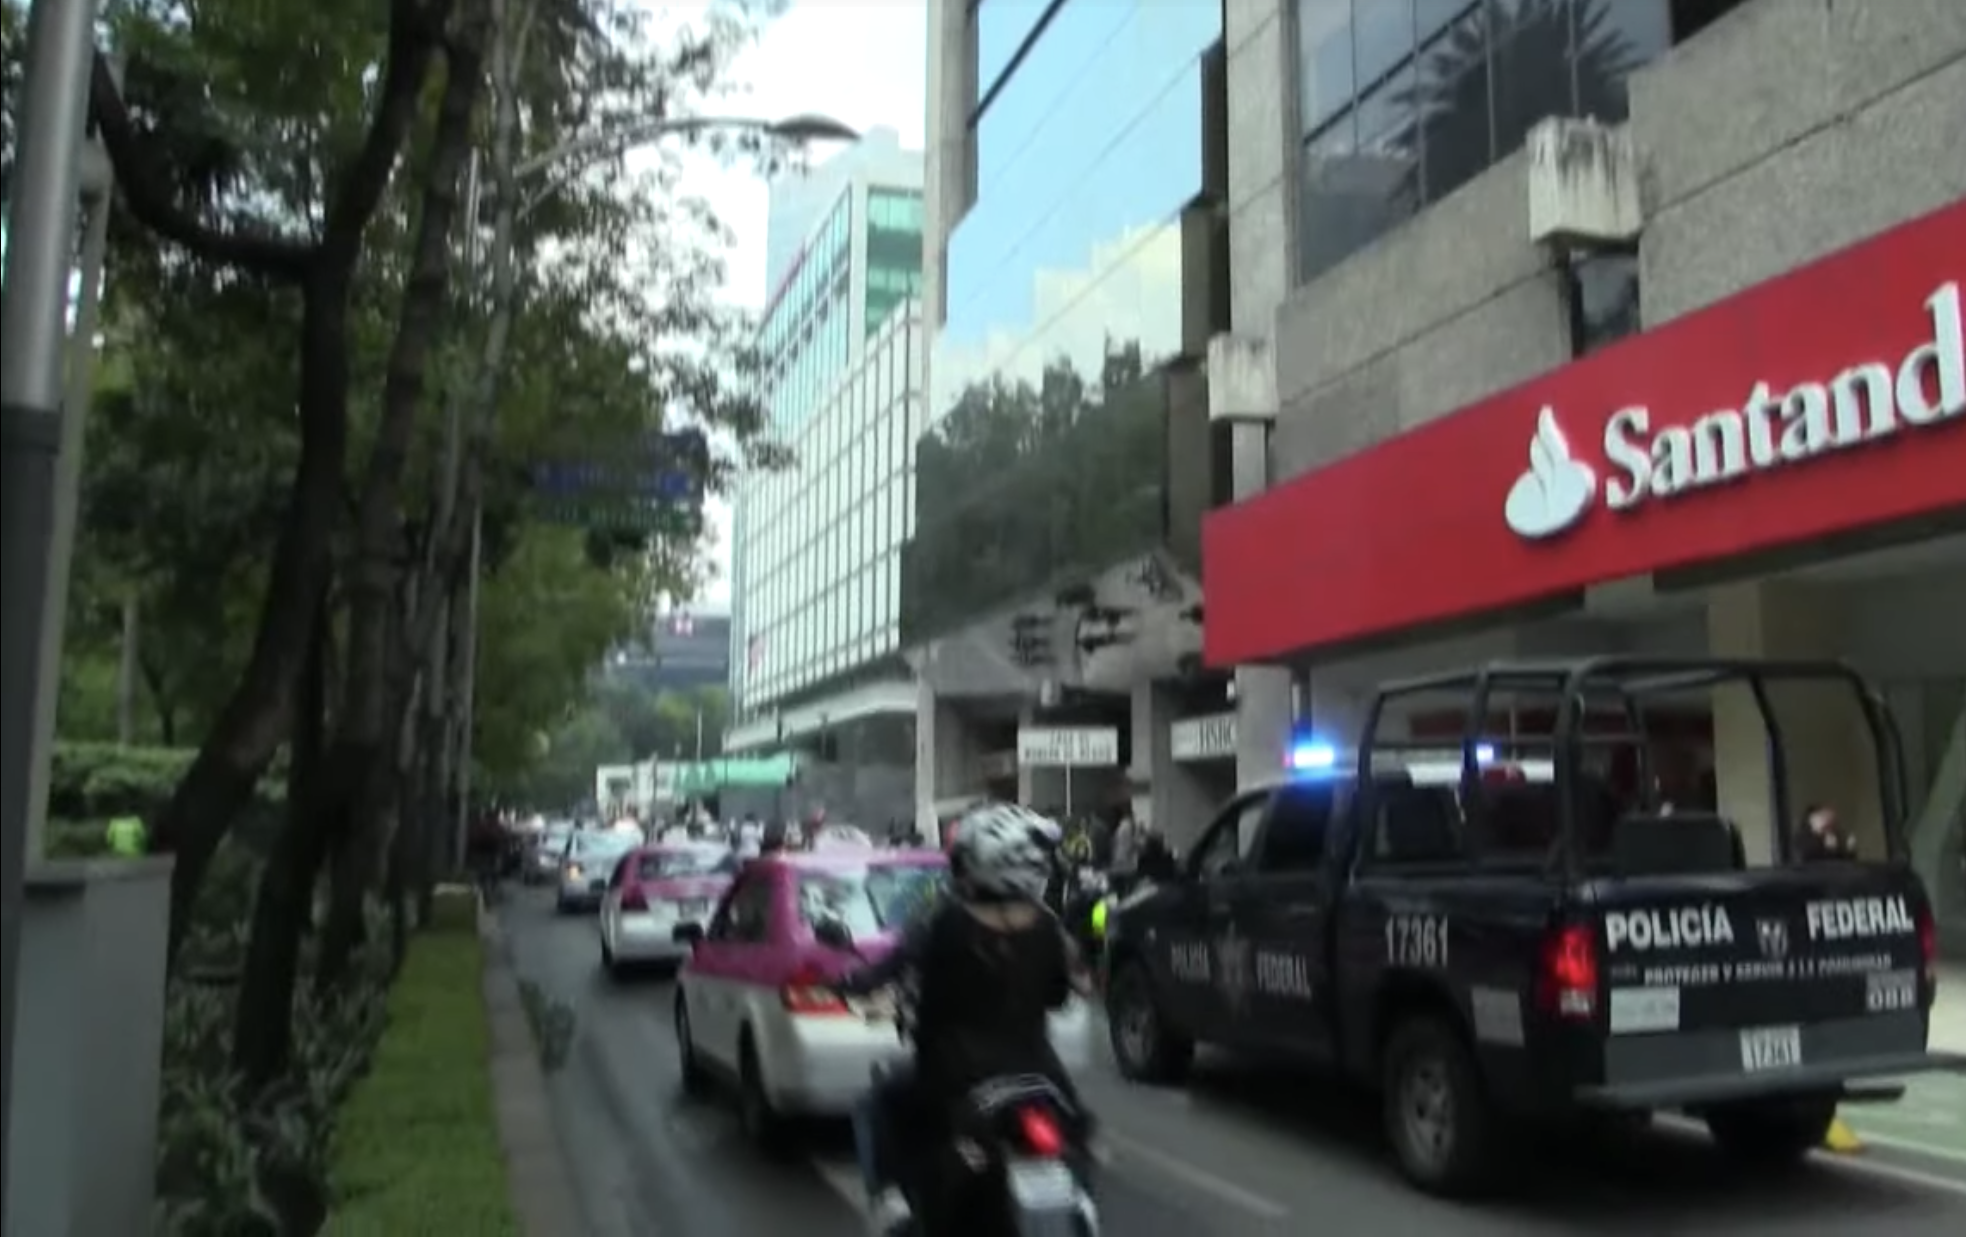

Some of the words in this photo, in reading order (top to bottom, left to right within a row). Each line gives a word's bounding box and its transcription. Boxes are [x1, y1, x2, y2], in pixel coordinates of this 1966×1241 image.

[1604, 281, 1966, 509] Santand
[1385, 914, 1449, 968] 17361
[1605, 903, 1735, 951] POLICÍA
[1806, 895, 1915, 941] FEDERAL
